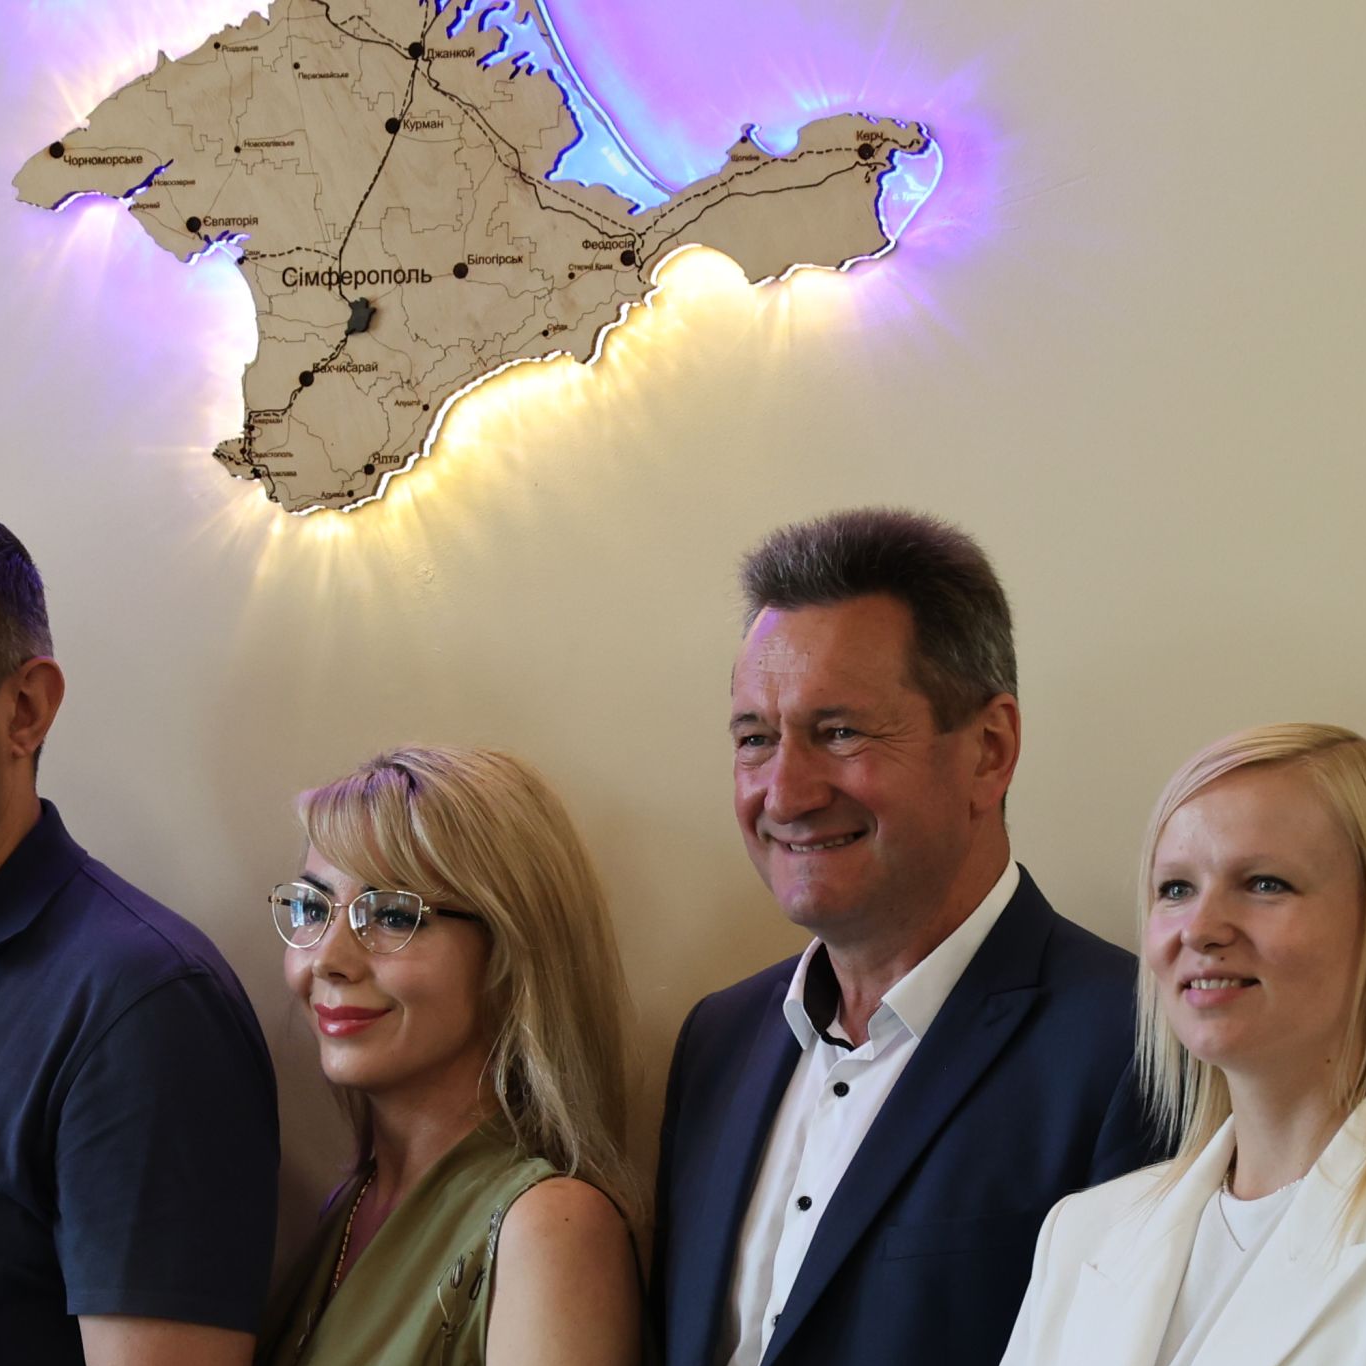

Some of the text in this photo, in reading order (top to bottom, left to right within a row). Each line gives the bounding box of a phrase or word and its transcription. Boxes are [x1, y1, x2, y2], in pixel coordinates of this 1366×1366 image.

[427, 47, 476, 60] Джанкой
[403, 119, 444, 132] Курман
[856, 130, 884, 142] Керч
[63, 154, 144, 168] Чорноморське
[203, 215, 259, 228] Євпаторія
[581, 239, 634, 251] Феодосія
[467, 253, 524, 267] Білогірськ
[282, 266, 433, 290] Сімферополь
[312, 362, 379, 376] Бахчисарай
[371, 454, 400, 466] Ялта
